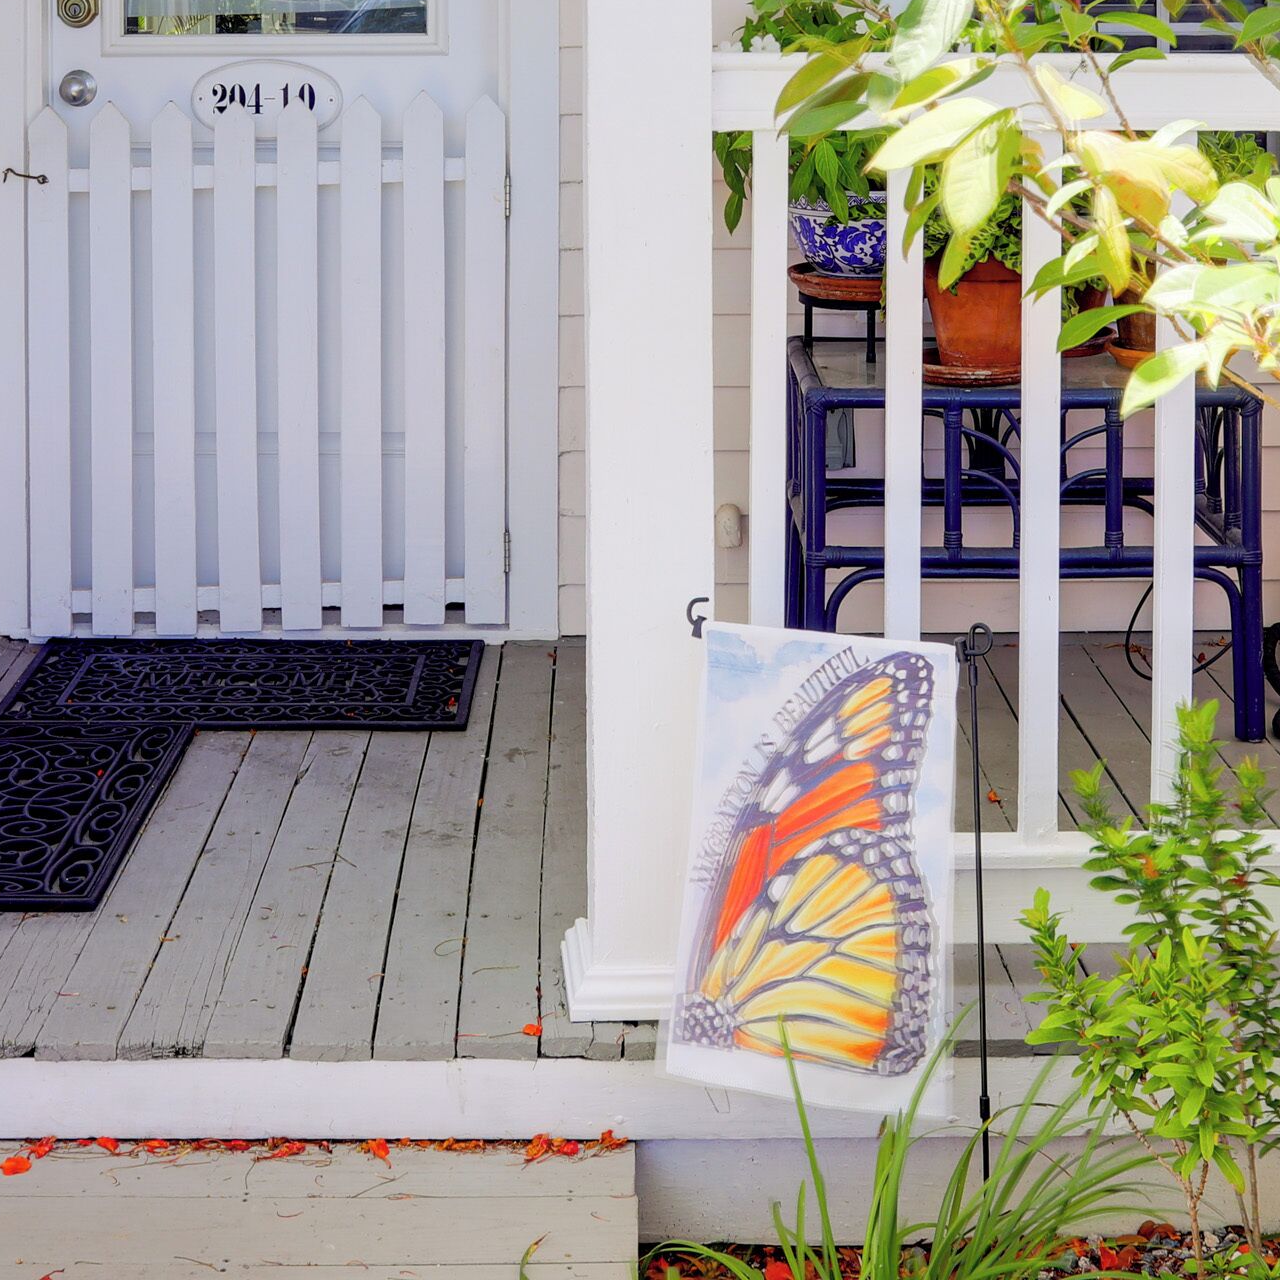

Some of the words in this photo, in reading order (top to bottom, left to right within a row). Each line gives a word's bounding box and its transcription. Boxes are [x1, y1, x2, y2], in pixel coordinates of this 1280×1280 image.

[212, 83, 316, 115] 204-10
[148, 671, 347, 688] WELCOME
[689, 756, 762, 891] MIGRATION
[754, 733, 778, 760] IS
[772, 645, 870, 736] BEAUTIFUL
